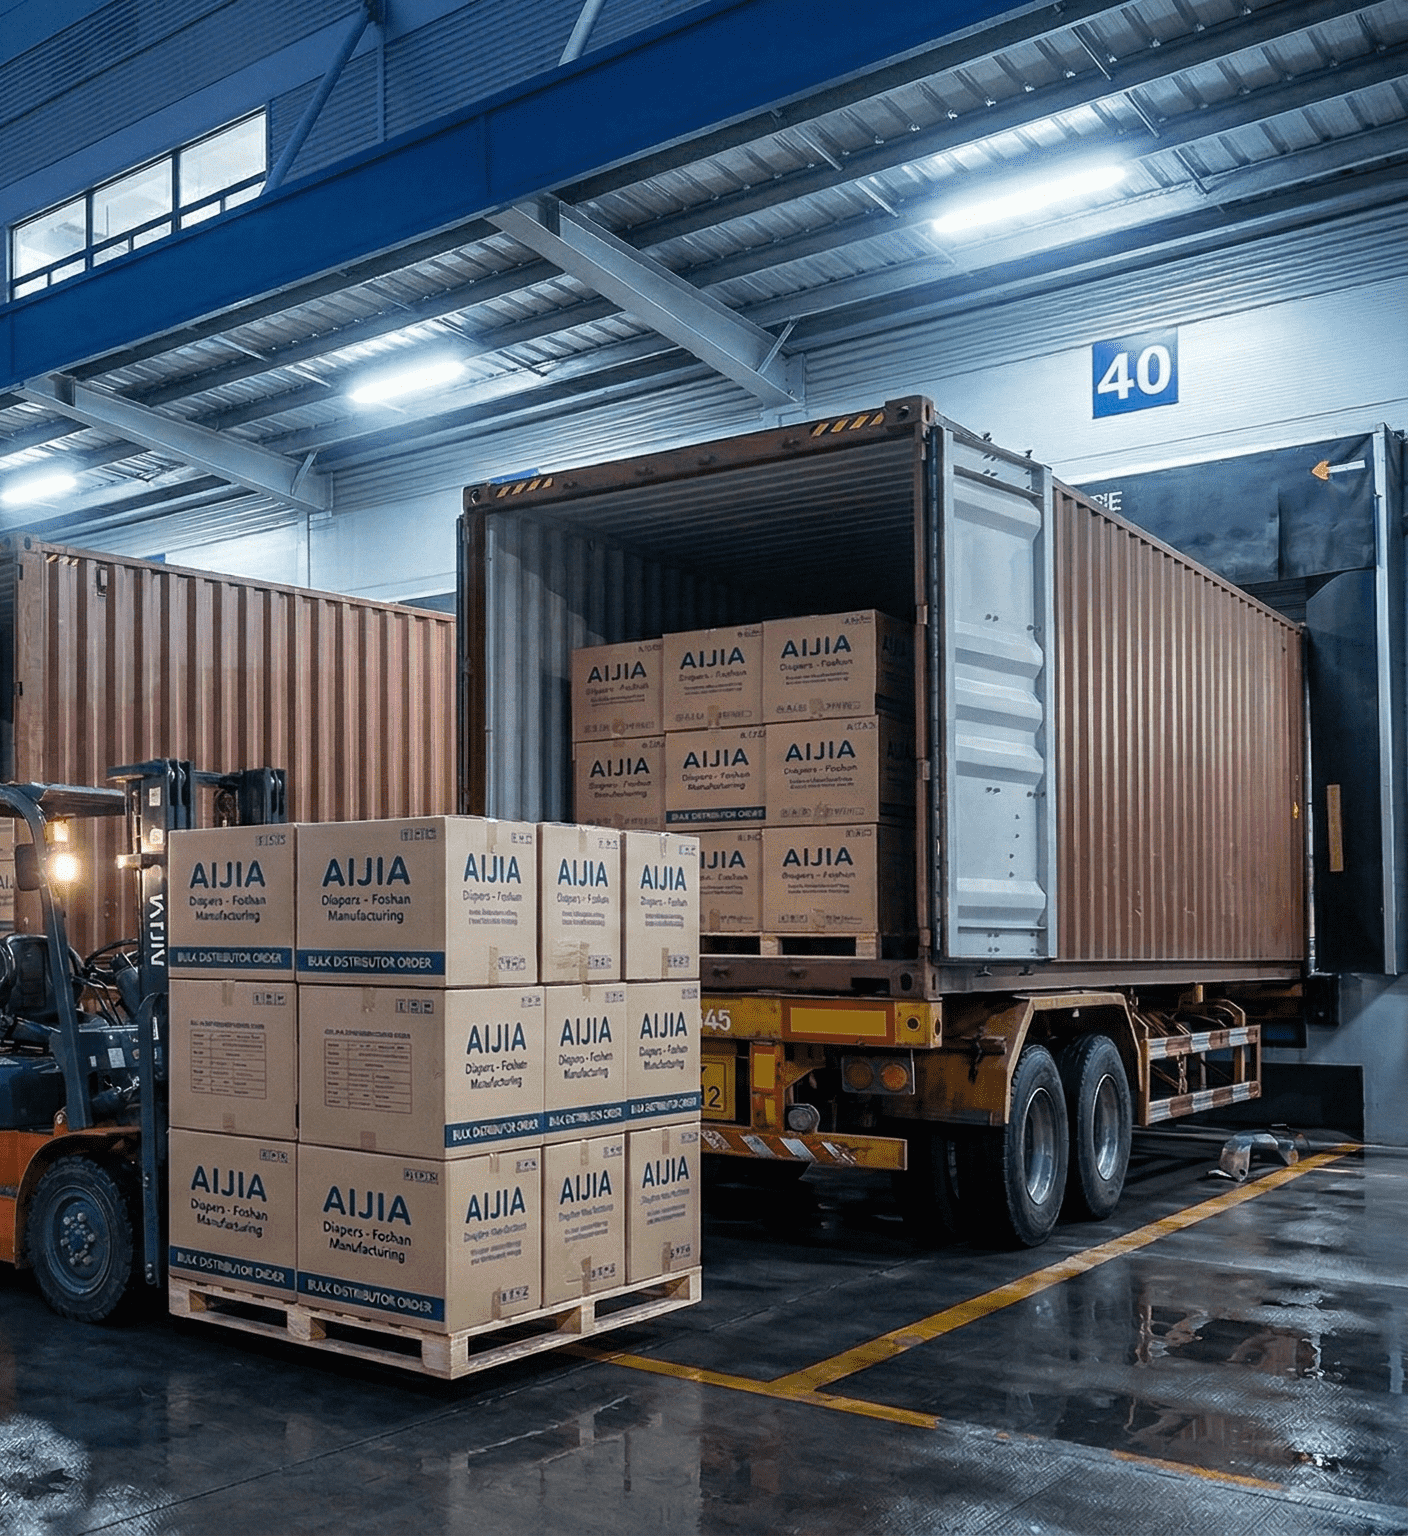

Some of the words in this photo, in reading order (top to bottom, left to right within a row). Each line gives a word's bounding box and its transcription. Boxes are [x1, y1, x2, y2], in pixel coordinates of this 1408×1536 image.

[1097, 345, 1171, 400] 40
[680, 647, 745, 670] AIJIA
[781, 635, 851, 658] AIJIA
[587, 661, 647, 683] AIJIA
[683, 748, 749, 769] AIJIA
[785, 740, 856, 762] AIJIA
[590, 757, 650, 778] AIJIA
[464, 853, 521, 884] AIJIA
[700, 850, 746, 869] IJIA
[782, 847, 854, 867] AIJIA
[190, 860, 265, 888] AIJIA
[322, 855, 410, 887] AIJIA
[558, 858, 608, 887] AIJIA
[641, 864, 687, 891] AIJIA
[328, 909, 404, 924] Manufacturing
[397, 957, 432, 968] ORDER
[560, 1016, 612, 1047] AIJIA
[640, 1011, 687, 1039] AIJIA
[701, 1009, 731, 1031] 45
[467, 1022, 526, 1054] AIJIA
[191, 1165, 267, 1202] AIJIA
[642, 1156, 689, 1188] AIJIA
[560, 1170, 612, 1205] AIJIA
[323, 1186, 411, 1225] AIJIA
[465, 1186, 526, 1224] AIJIA
[323, 1221, 363, 1238] Diapers
[330, 1237, 405, 1264] Manufacturing
